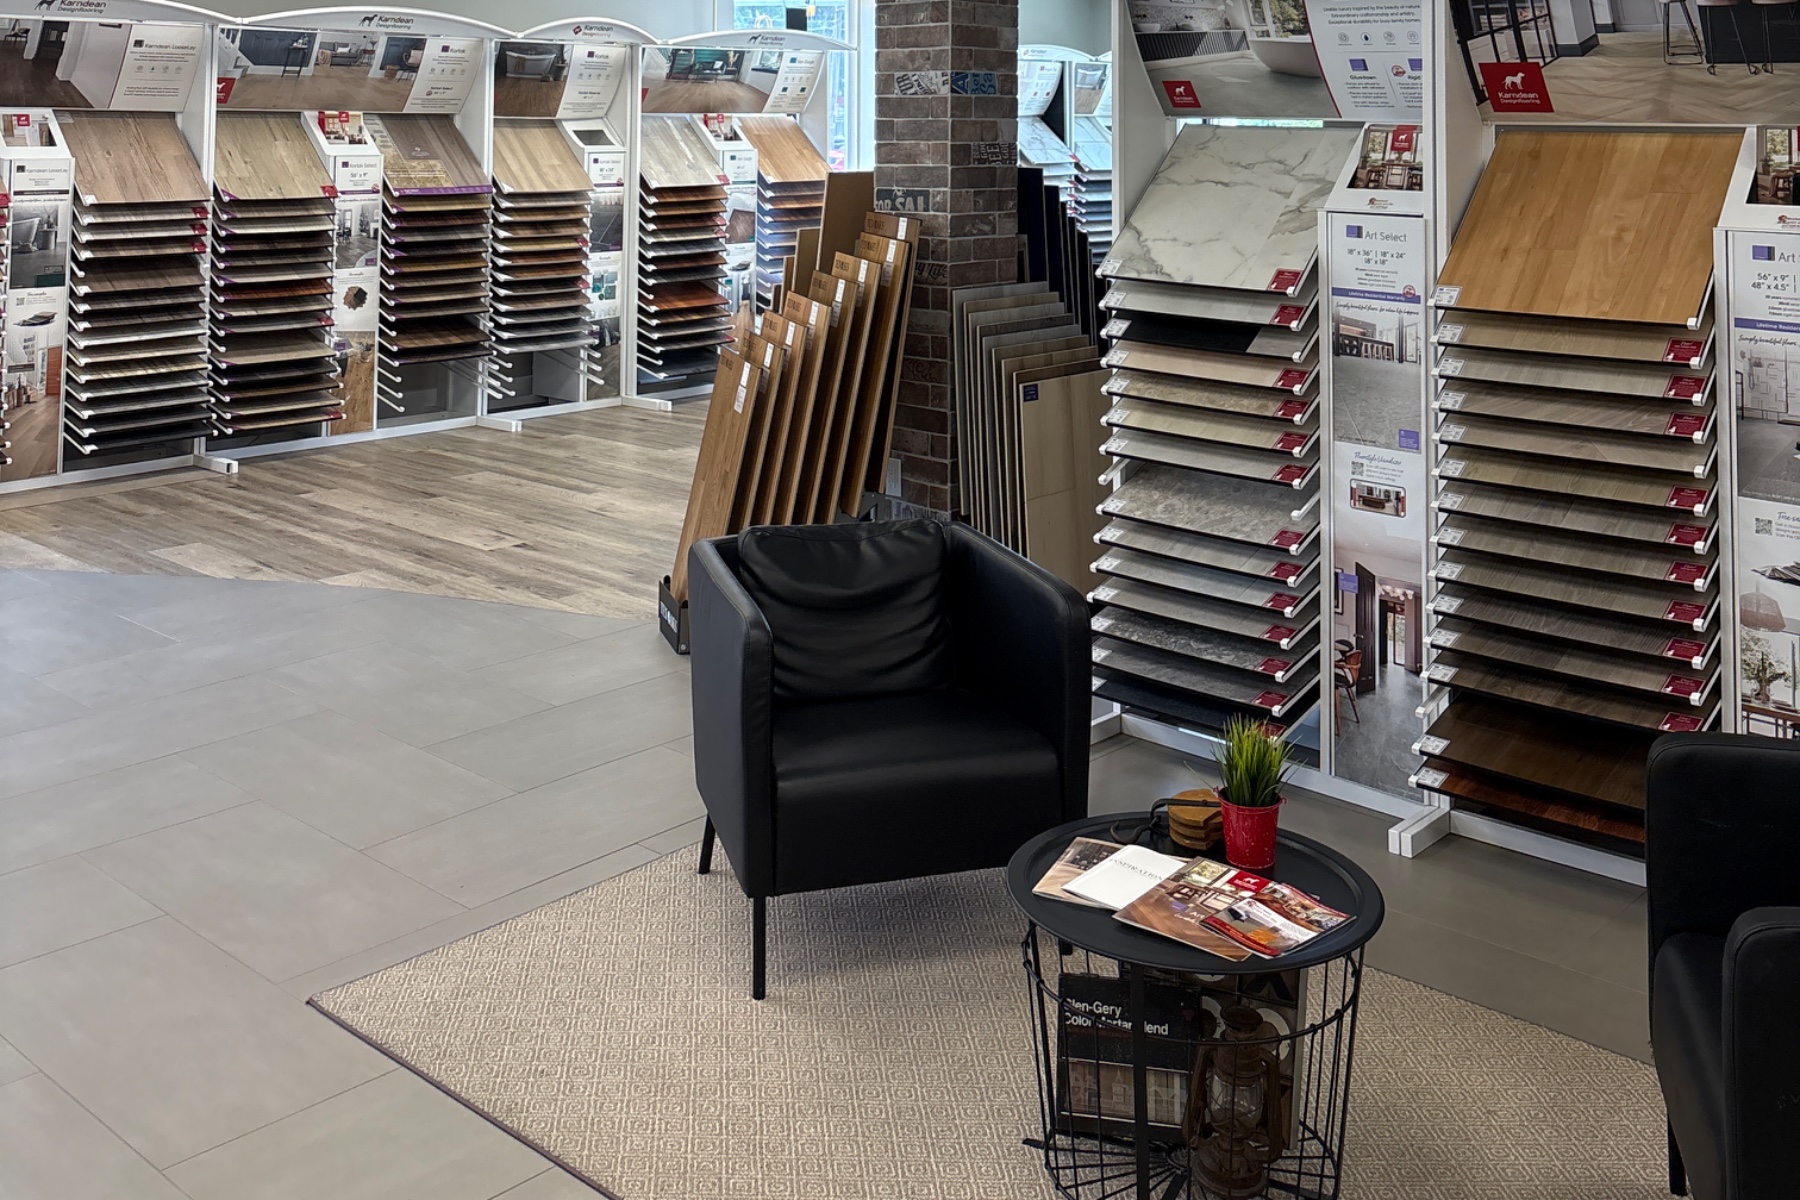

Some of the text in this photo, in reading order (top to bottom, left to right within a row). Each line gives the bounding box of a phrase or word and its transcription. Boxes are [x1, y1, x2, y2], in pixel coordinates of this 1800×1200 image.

[57, 6, 104, 14] Designflooring
[378, 15, 414, 24] Karndean
[584, 24, 614, 32] Karndean
[1365, 231, 1407, 242] Art Select
[1778, 252, 1796, 263] Art
[1757, 273, 1771, 281] 56"
[1751, 281, 1765, 289] 48"
[1738, 335, 1758, 345] Simply
[1144, 1021, 1169, 1035] lend
